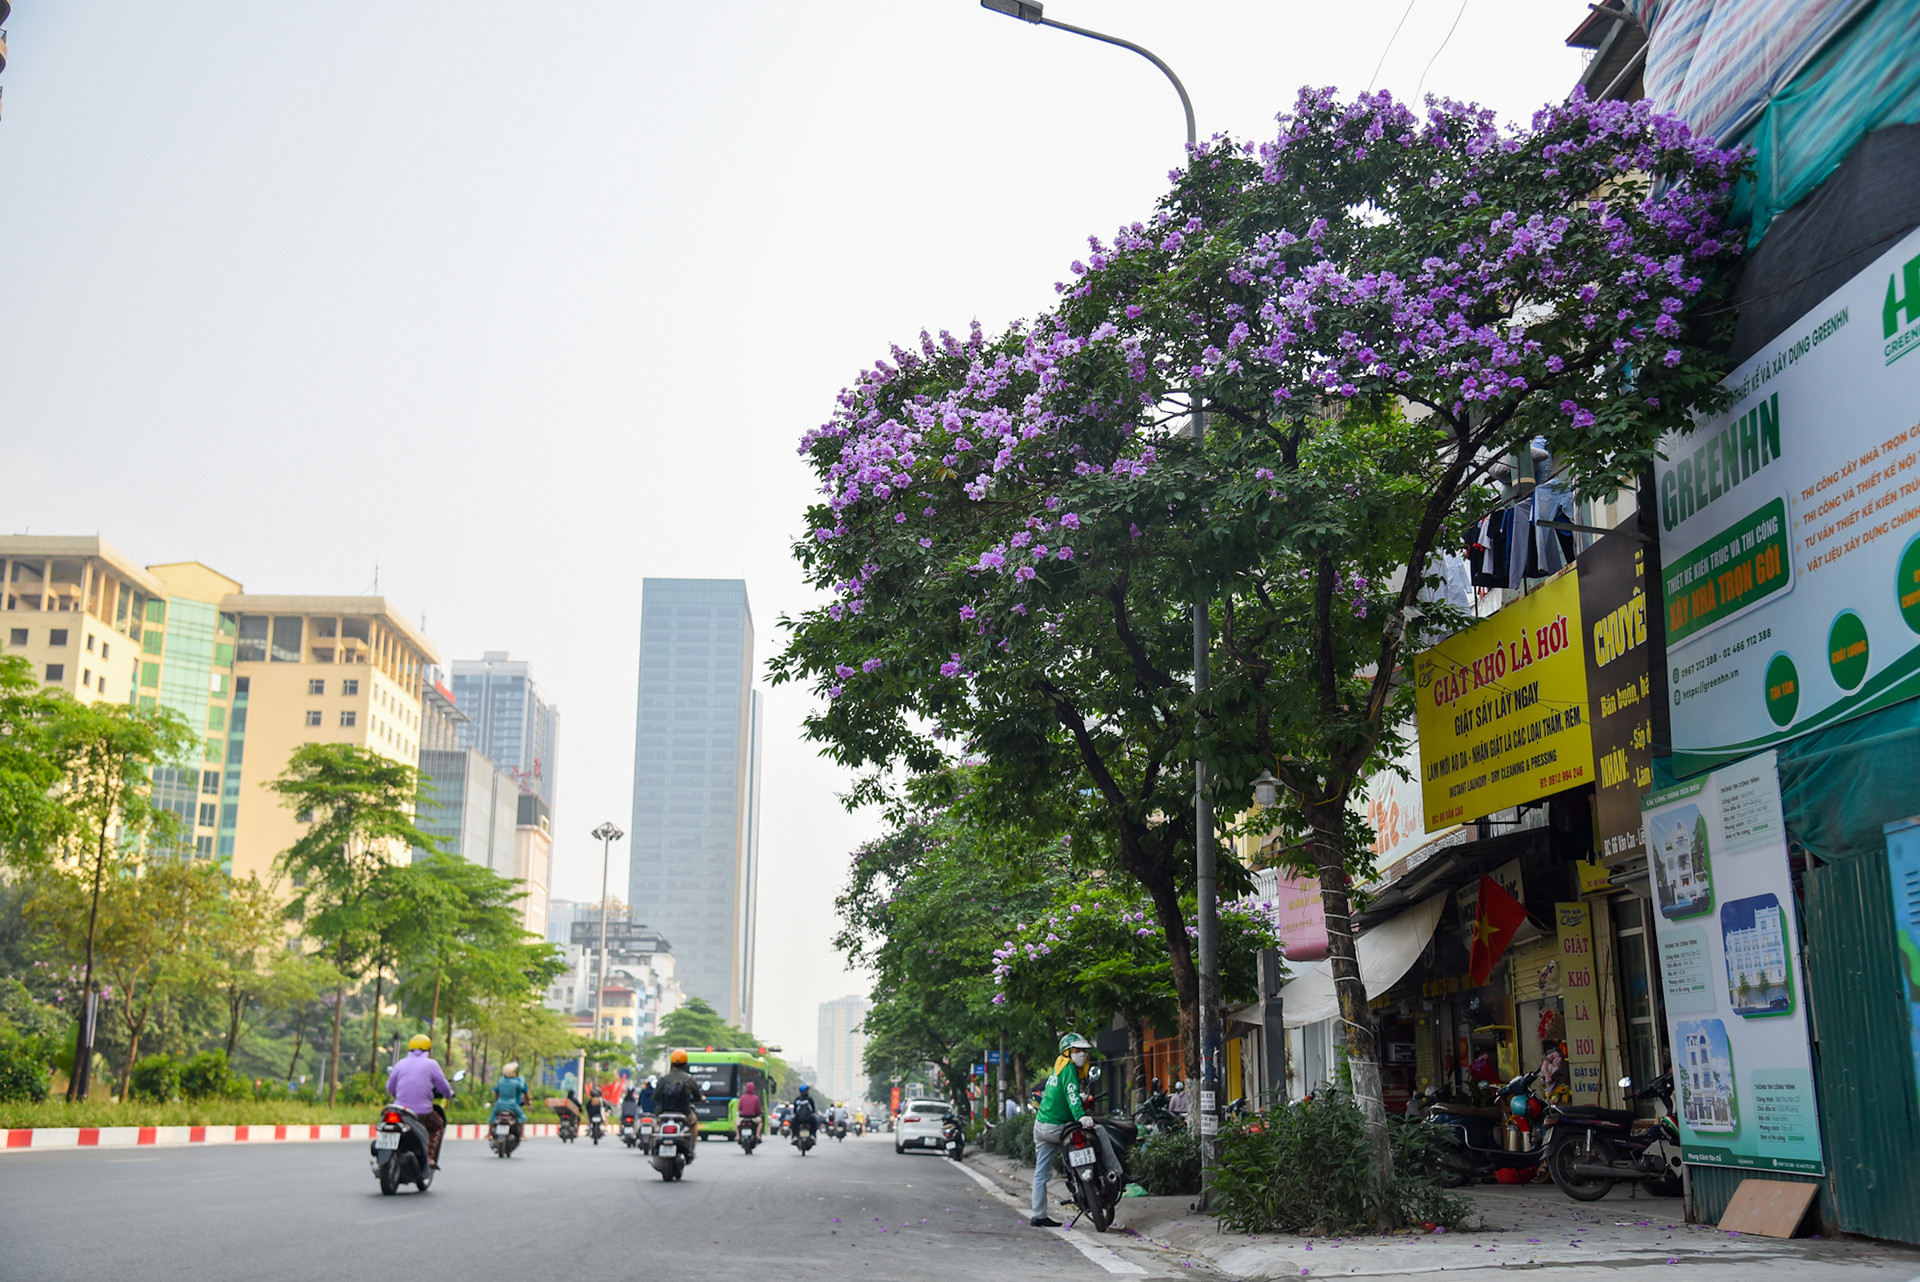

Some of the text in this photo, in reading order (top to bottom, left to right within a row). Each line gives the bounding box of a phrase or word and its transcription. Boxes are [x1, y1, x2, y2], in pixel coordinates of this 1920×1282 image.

[1752, 364, 1760, 392] KẾ
[1761, 361, 1771, 385] VÀ
[1772, 352, 1787, 377] XÂY
[1788, 336, 1810, 366] DỰNG
[1812, 306, 1849, 346] GREENHN
[1884, 323, 1920, 357] GREEN
[1661, 392, 1781, 532] GREENHN
[1801, 485, 1815, 501] THI
[1816, 471, 1839, 493] CÔNG
[1840, 460, 1858, 478] XÂY
[1860, 446, 1880, 468] NHÀ
[1881, 431, 1908, 454] TRỌN
[1803, 452, 1916, 525] THI CÔNG VÀ THIẾT KẾ NỘI
[1805, 476, 1920, 548] TƯ VẤN THIẾT KẾ KIẾN TRÚ
[1666, 516, 1778, 596] THIẾT KẾ KIẾN TRÚC VÀ THI CÔNG
[1806, 556, 1822, 573] VẬT
[1824, 546, 1842, 564] LIỆU
[1844, 535, 1861, 554] XÂY
[1863, 522, 1890, 544] DỰNG
[1669, 542, 1781, 633] XÂY NHÀ TRỌN GÓI
[1594, 586, 1647, 668] CHUYÊ
[1722, 647, 1731, 659] 02
[1746, 634, 1757, 648] 712
[1758, 628, 1772, 642] 388
[1433, 613, 1569, 708] GIẶT KHÔ LÀ HƠI
[1454, 680, 1539, 738] GIẶT SẤY LẤY NGAY
[1601, 693, 1617, 719] Bán
[1427, 760, 1439, 782] LÀM
[1460, 750, 1468, 769] DA
[1504, 728, 1512, 752] LÀ
[1513, 724, 1526, 750] CÁC
[1528, 719, 1542, 746] LOẠI
[1449, 780, 1467, 798] INSTANT
[1468, 774, 1487, 794] LAUNDRY
[1491, 770, 1500, 784] DRY
[1501, 760, 1525, 781] CLEANING
[1526, 760, 1530, 772] &
[1531, 749, 1557, 770] PRESSING
[1600, 744, 1630, 790] NHẬN:
[1564, 934, 1590, 958] GIẶT
[1568, 966, 1591, 987] KHÔ
[1575, 1001, 1590, 1021] LÀ
[1576, 1036, 1595, 1056] HƠI
[1067, 1082, 1079, 1105] Grab
[1575, 1080, 1586, 1092] LẤY
